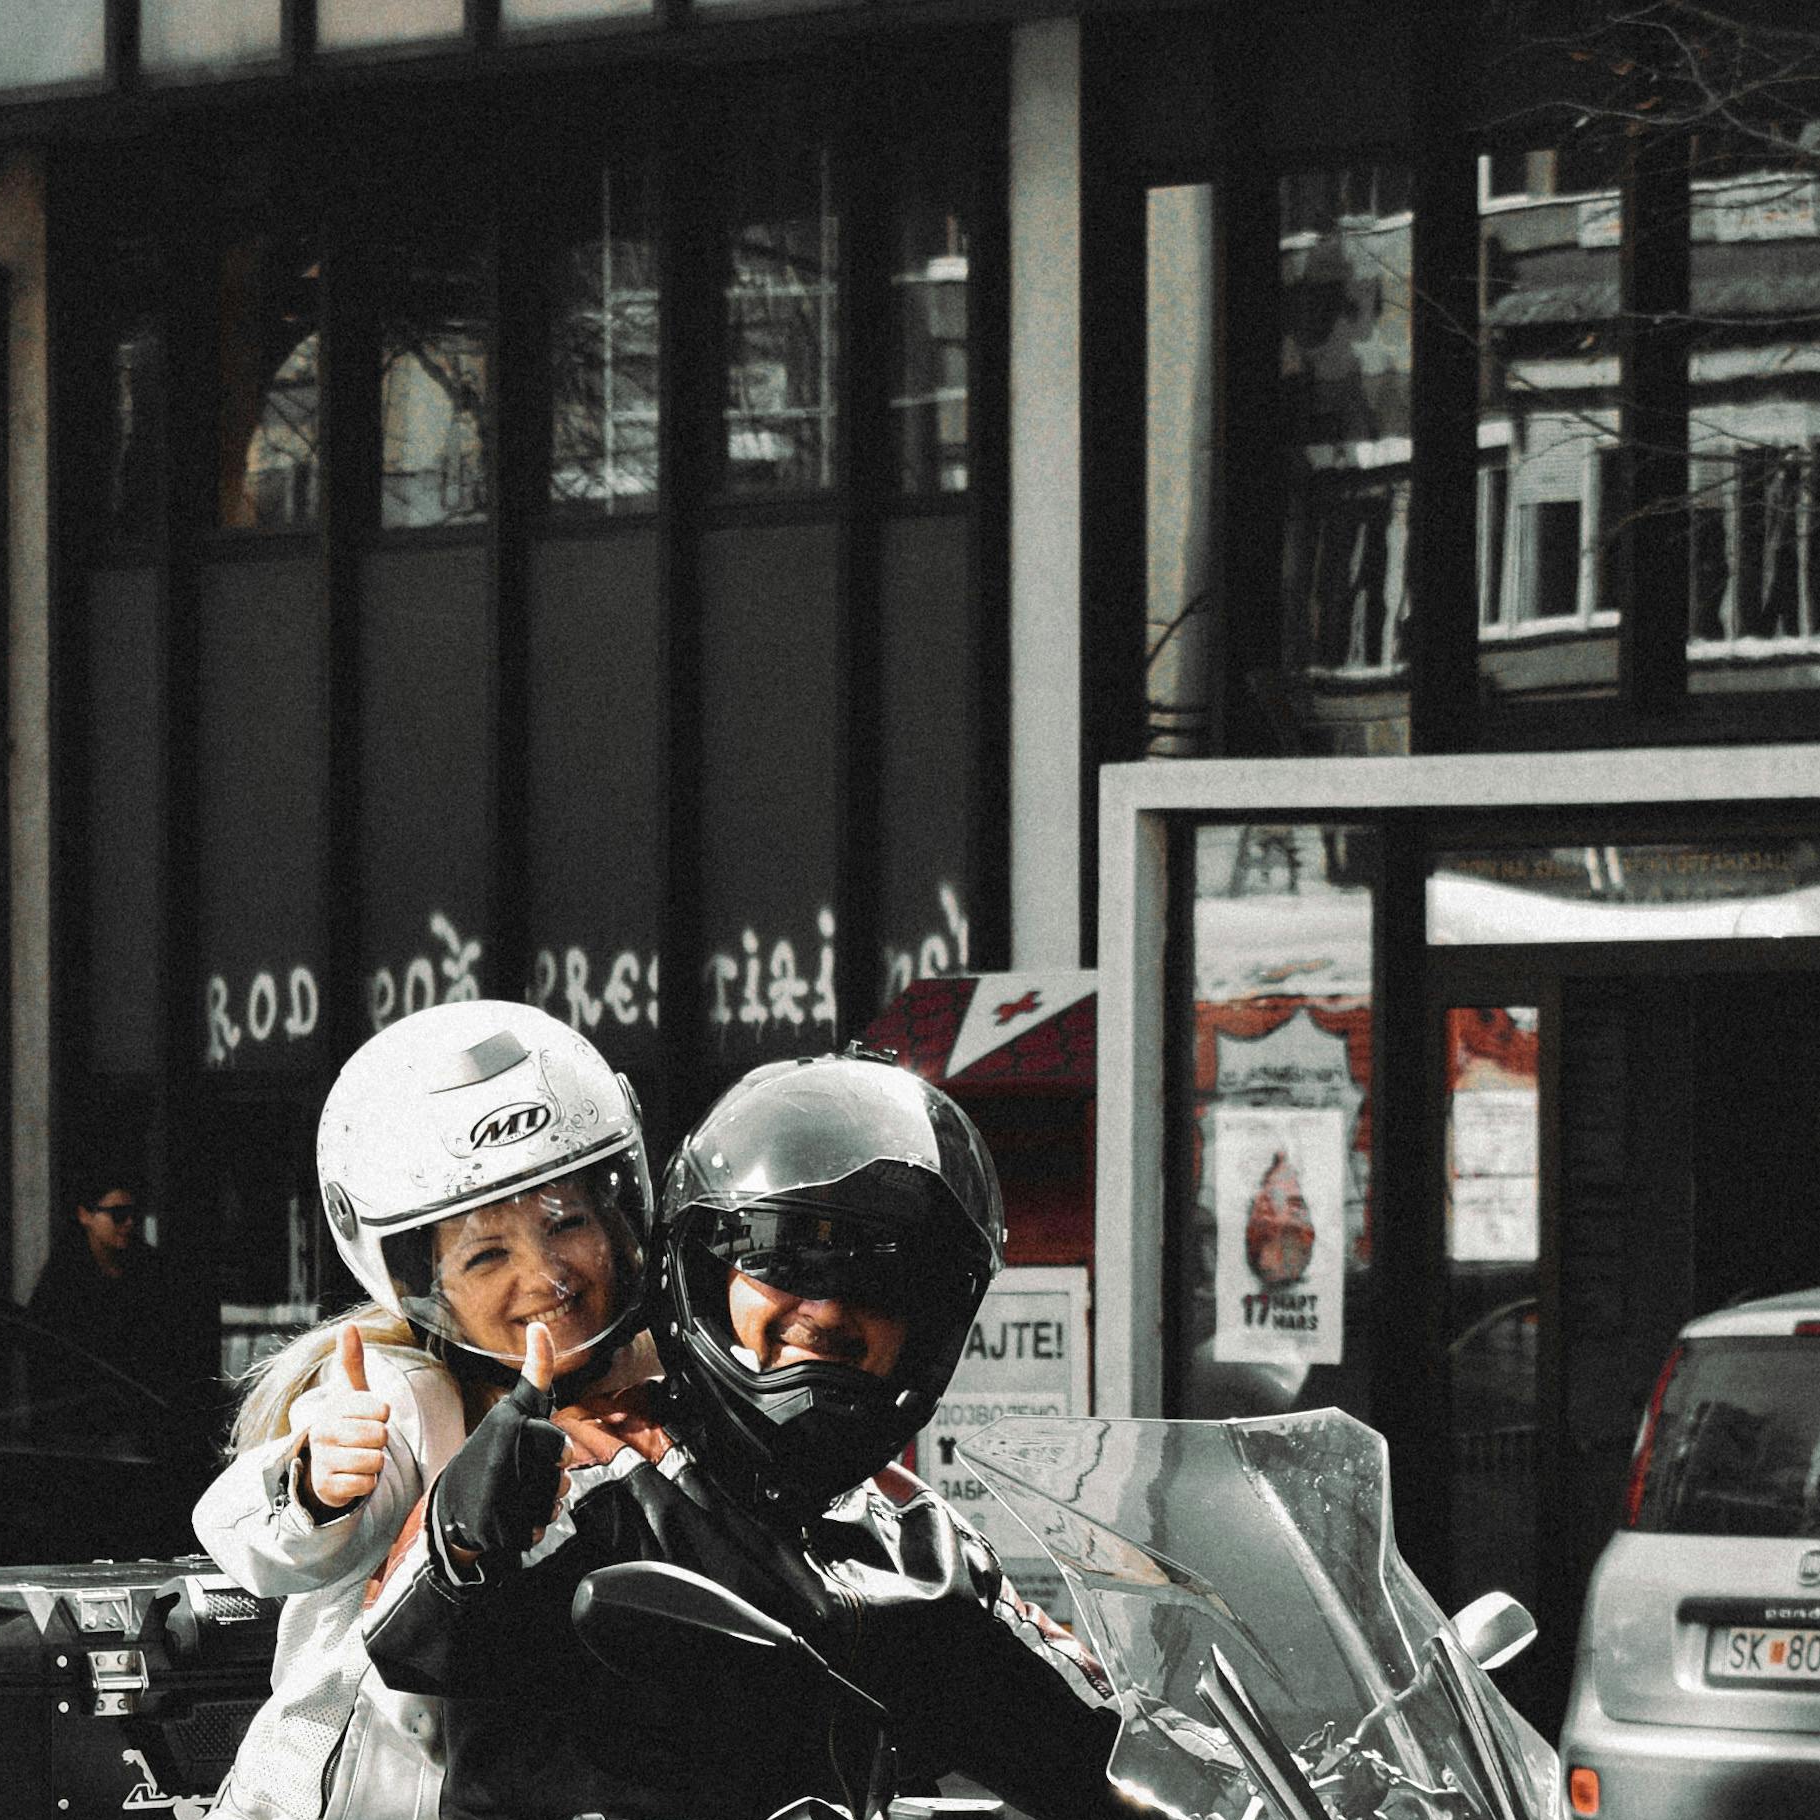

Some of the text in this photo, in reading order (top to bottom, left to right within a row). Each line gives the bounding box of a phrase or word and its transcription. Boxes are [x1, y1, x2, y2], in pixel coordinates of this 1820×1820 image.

[472, 1104, 546, 1150] MT
[1241, 1293, 1270, 1327] 17
[1730, 1632, 1767, 1671] SK
